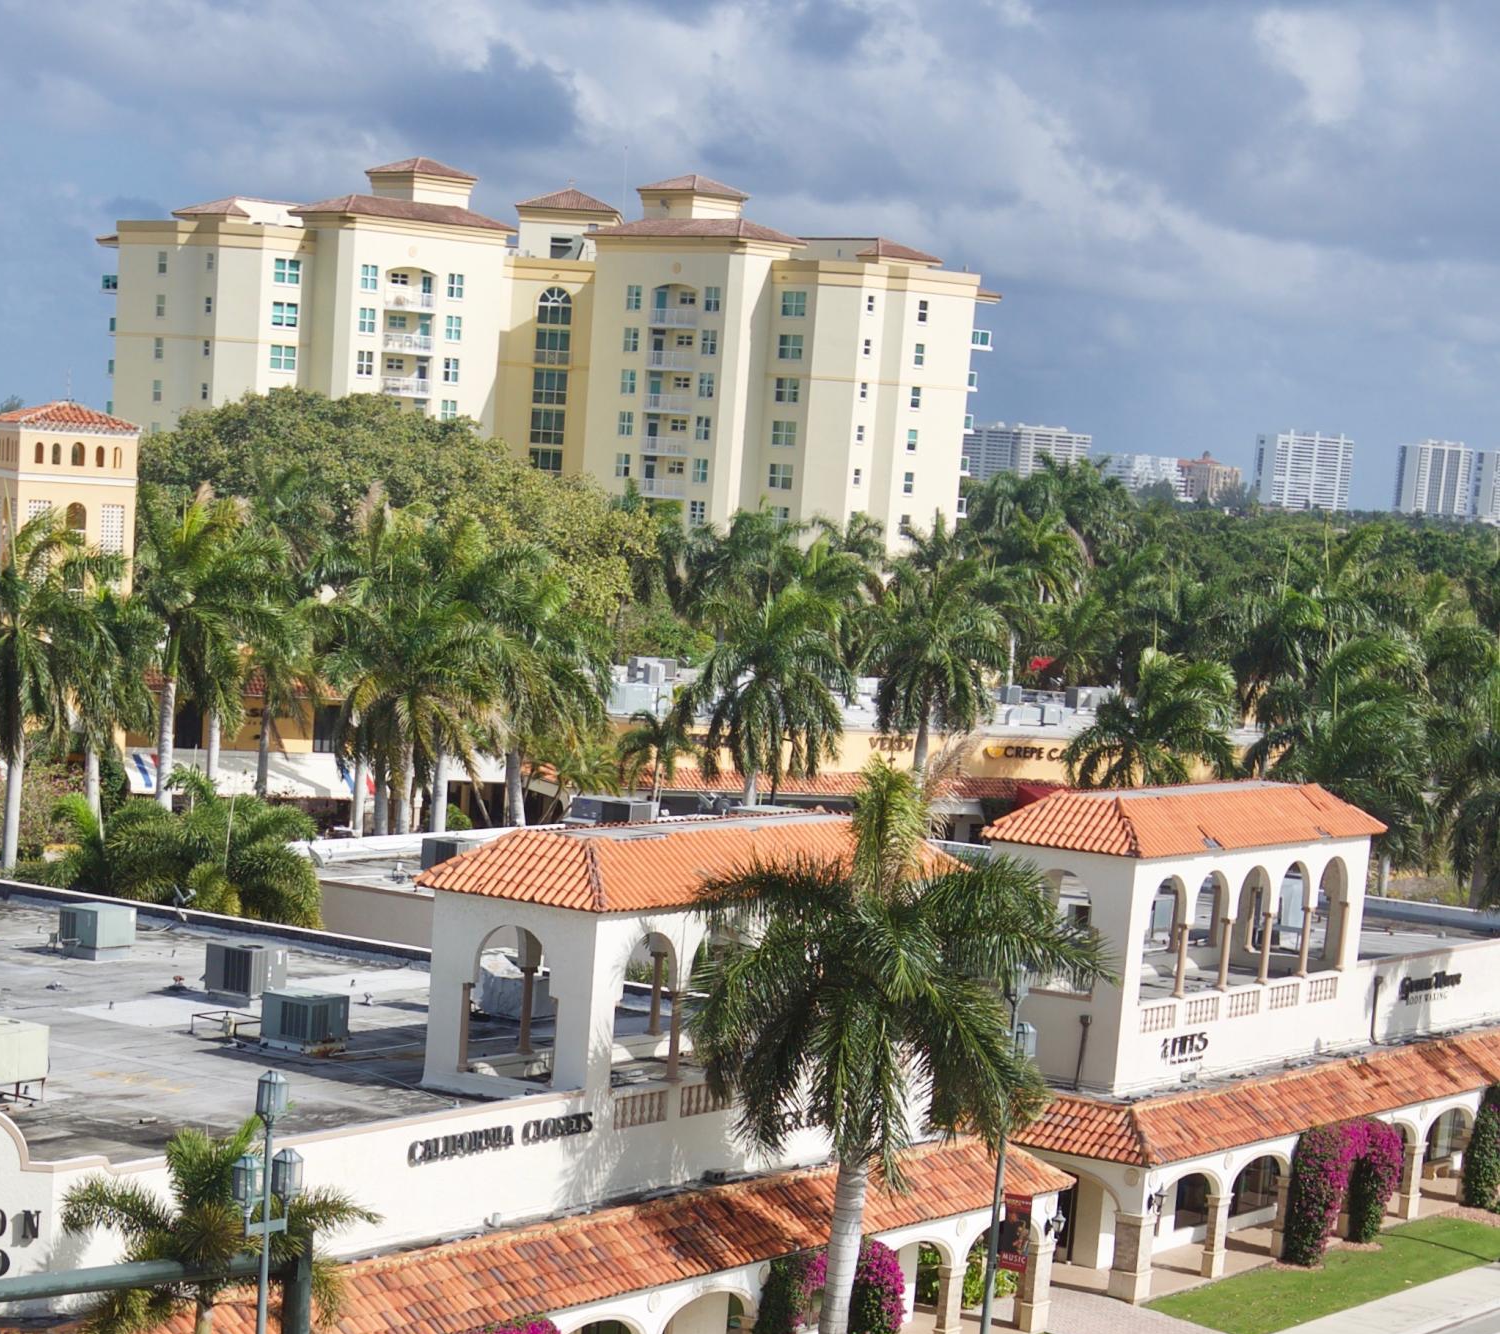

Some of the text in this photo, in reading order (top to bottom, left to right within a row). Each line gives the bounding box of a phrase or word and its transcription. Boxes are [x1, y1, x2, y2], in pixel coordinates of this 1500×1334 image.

[1004, 745, 1044, 761] CREPE
[407, 1112, 593, 1167] CALIFORNIA CLOSETS
[1002, 1253, 1026, 1264] MUSIC
